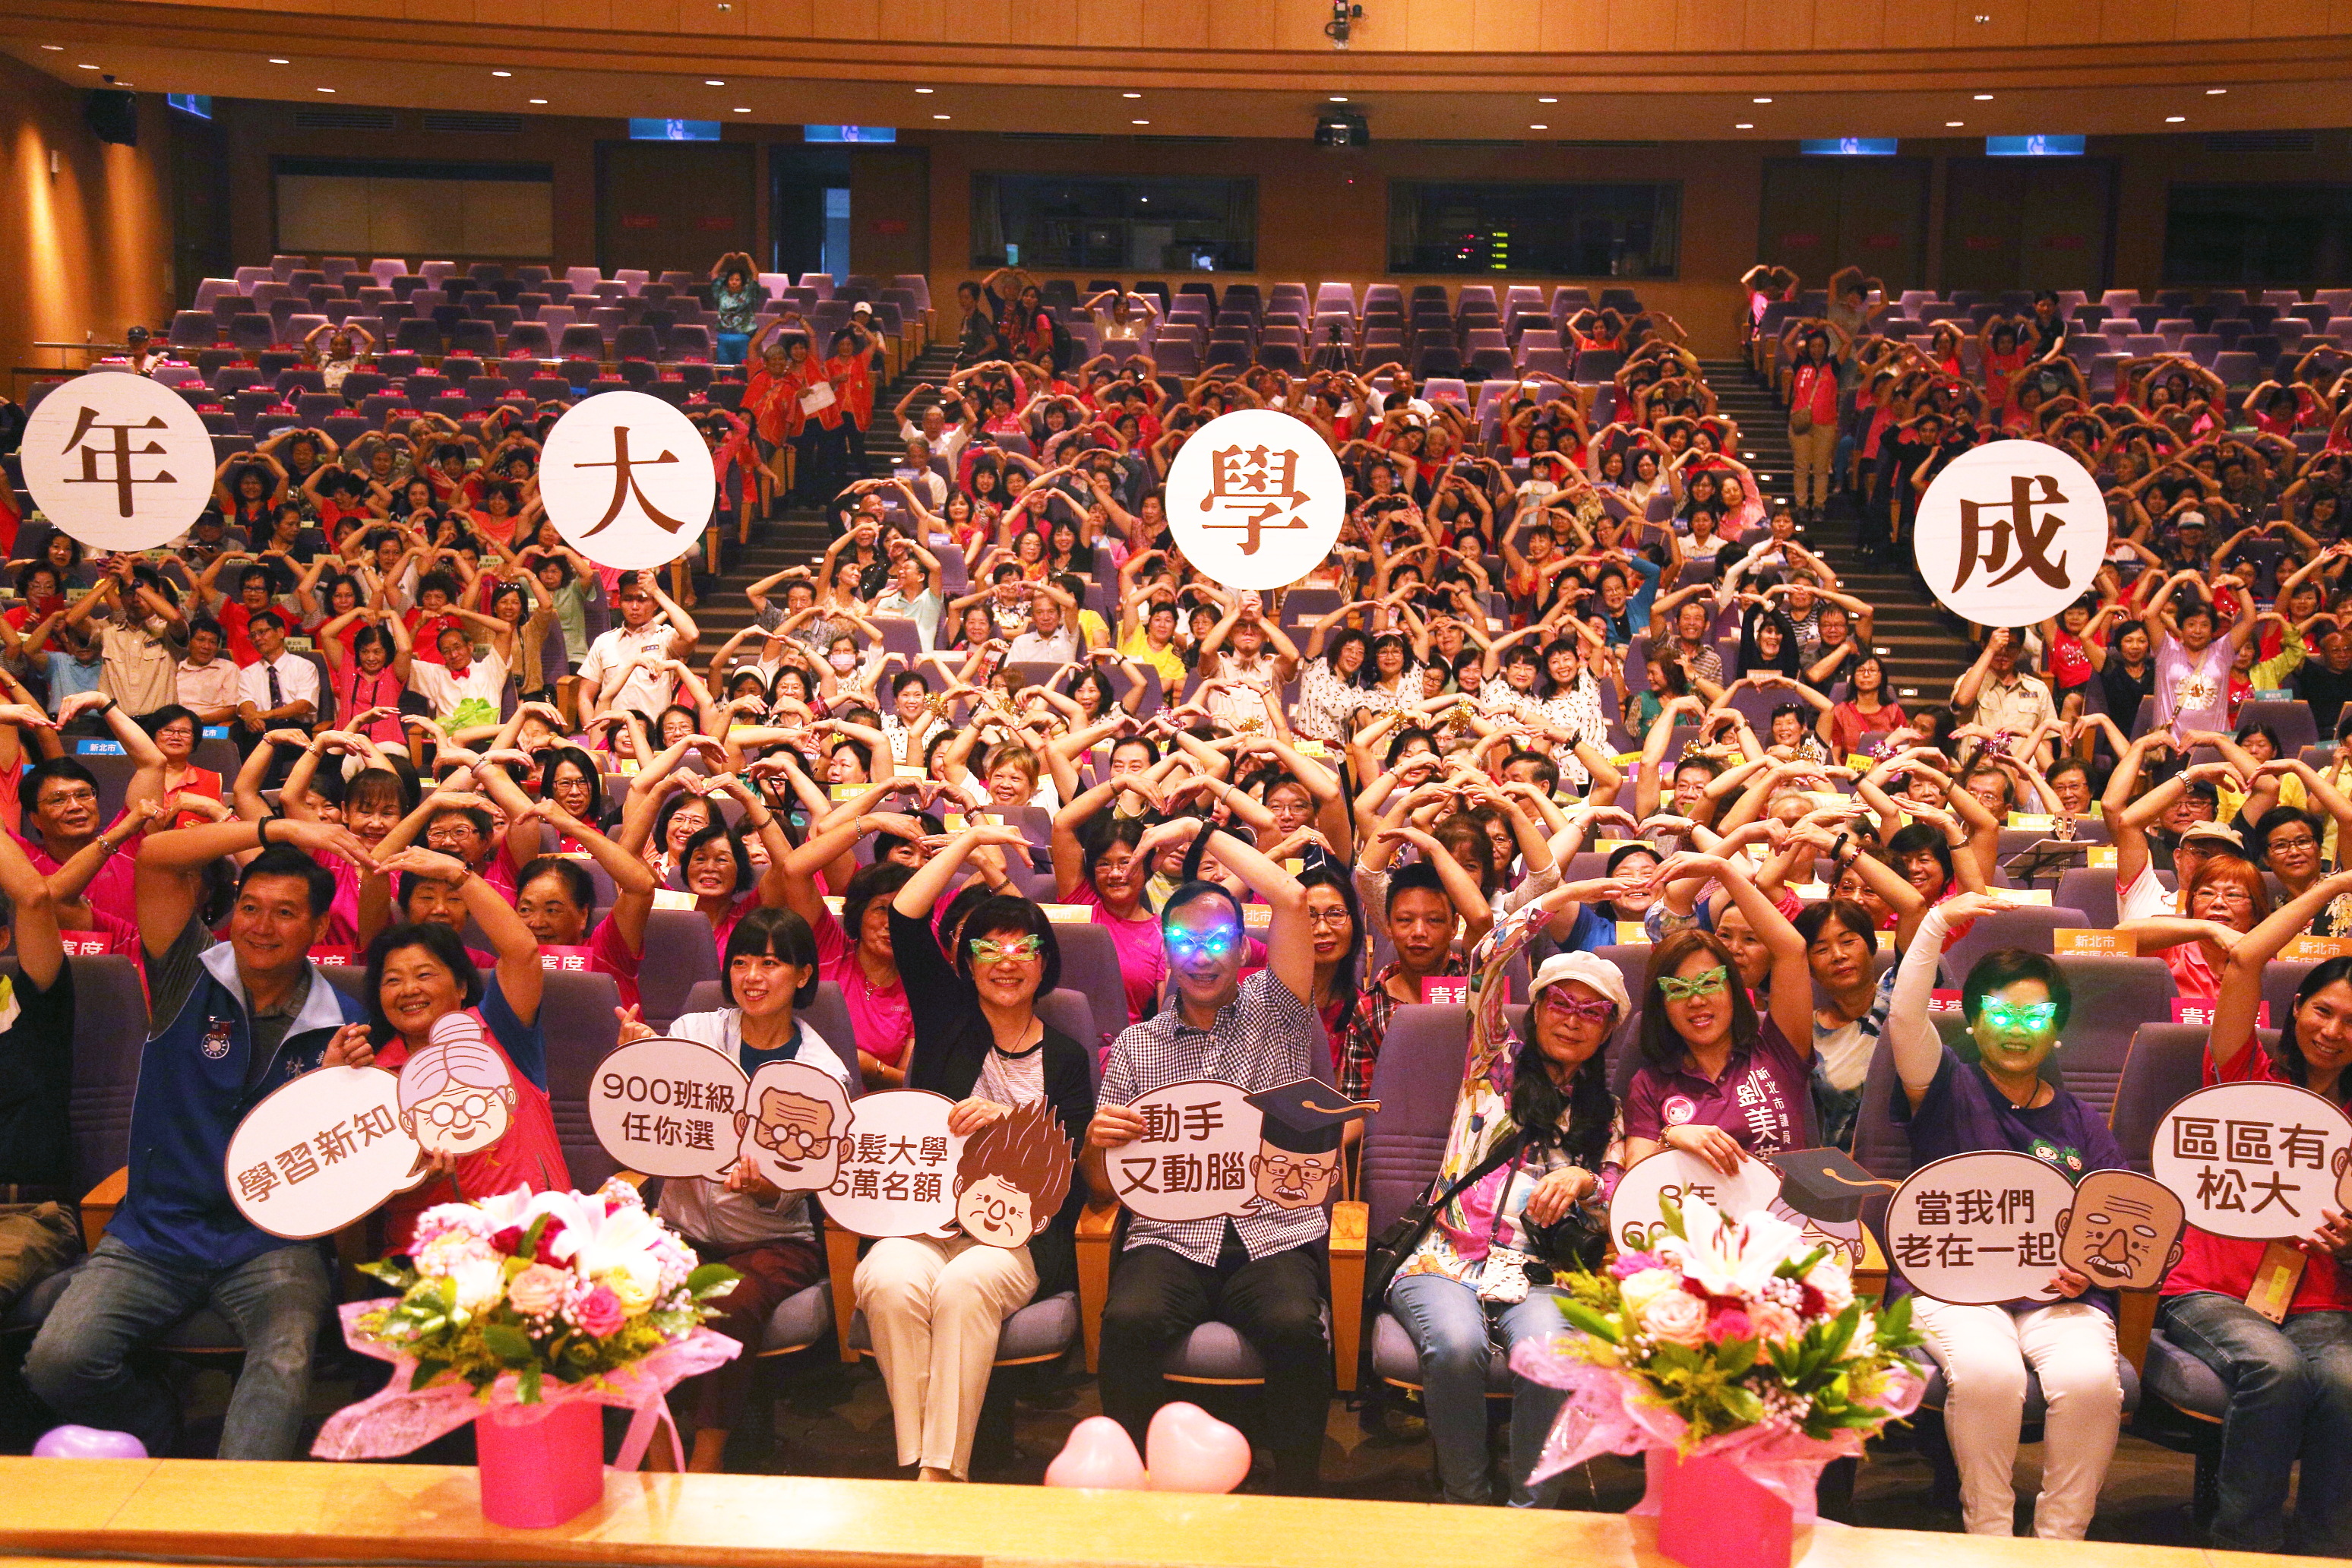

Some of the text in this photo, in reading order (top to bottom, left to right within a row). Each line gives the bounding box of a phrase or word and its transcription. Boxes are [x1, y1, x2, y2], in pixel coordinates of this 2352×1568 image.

[62, 406, 179, 518] 年
[574, 425, 686, 539] 大
[1200, 444, 1311, 556] 學
[1950, 475, 2072, 595] 成
[89, 743, 116, 752] 新北市
[2075, 934, 2116, 948] 新北市
[2299, 941, 2341, 956] 新北市
[602, 1073, 735, 1115] 900班級
[1755, 1067, 1791, 1145] 新北市議員
[621, 1111, 715, 1151] 任你選
[1140, 1101, 1225, 1144] 動手
[2172, 1115, 2331, 1171] 區區有
[237, 1103, 398, 1203] 學習新知
[848, 1133, 948, 1167] 髮大學
[1120, 1151, 1245, 1197] 又動腦
[2196, 1165, 2301, 1218] 松大
[1915, 1187, 2035, 1226] 當我們
[1895, 1231, 2059, 1269] 老在一起
